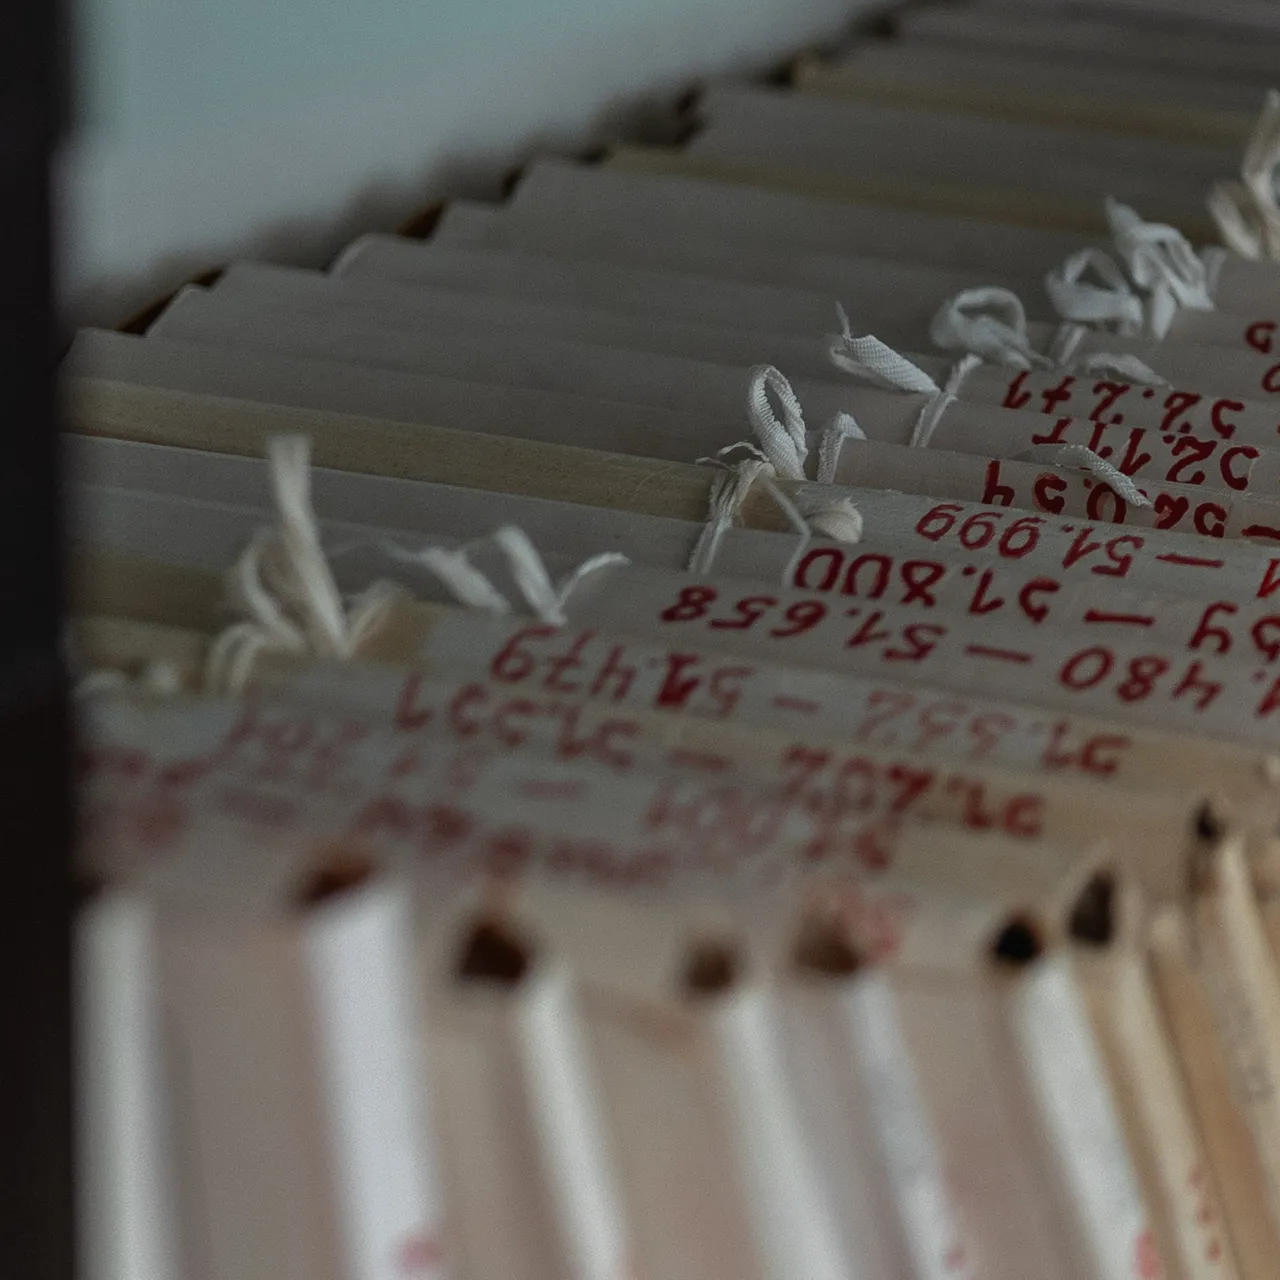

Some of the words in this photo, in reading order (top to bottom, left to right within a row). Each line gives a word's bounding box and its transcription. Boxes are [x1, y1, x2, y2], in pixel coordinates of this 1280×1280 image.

[915, 502, 1144, 577] 51.999
[661, 585, 948, 662] 51.658
[489, 624, 755, 709] 51.479
